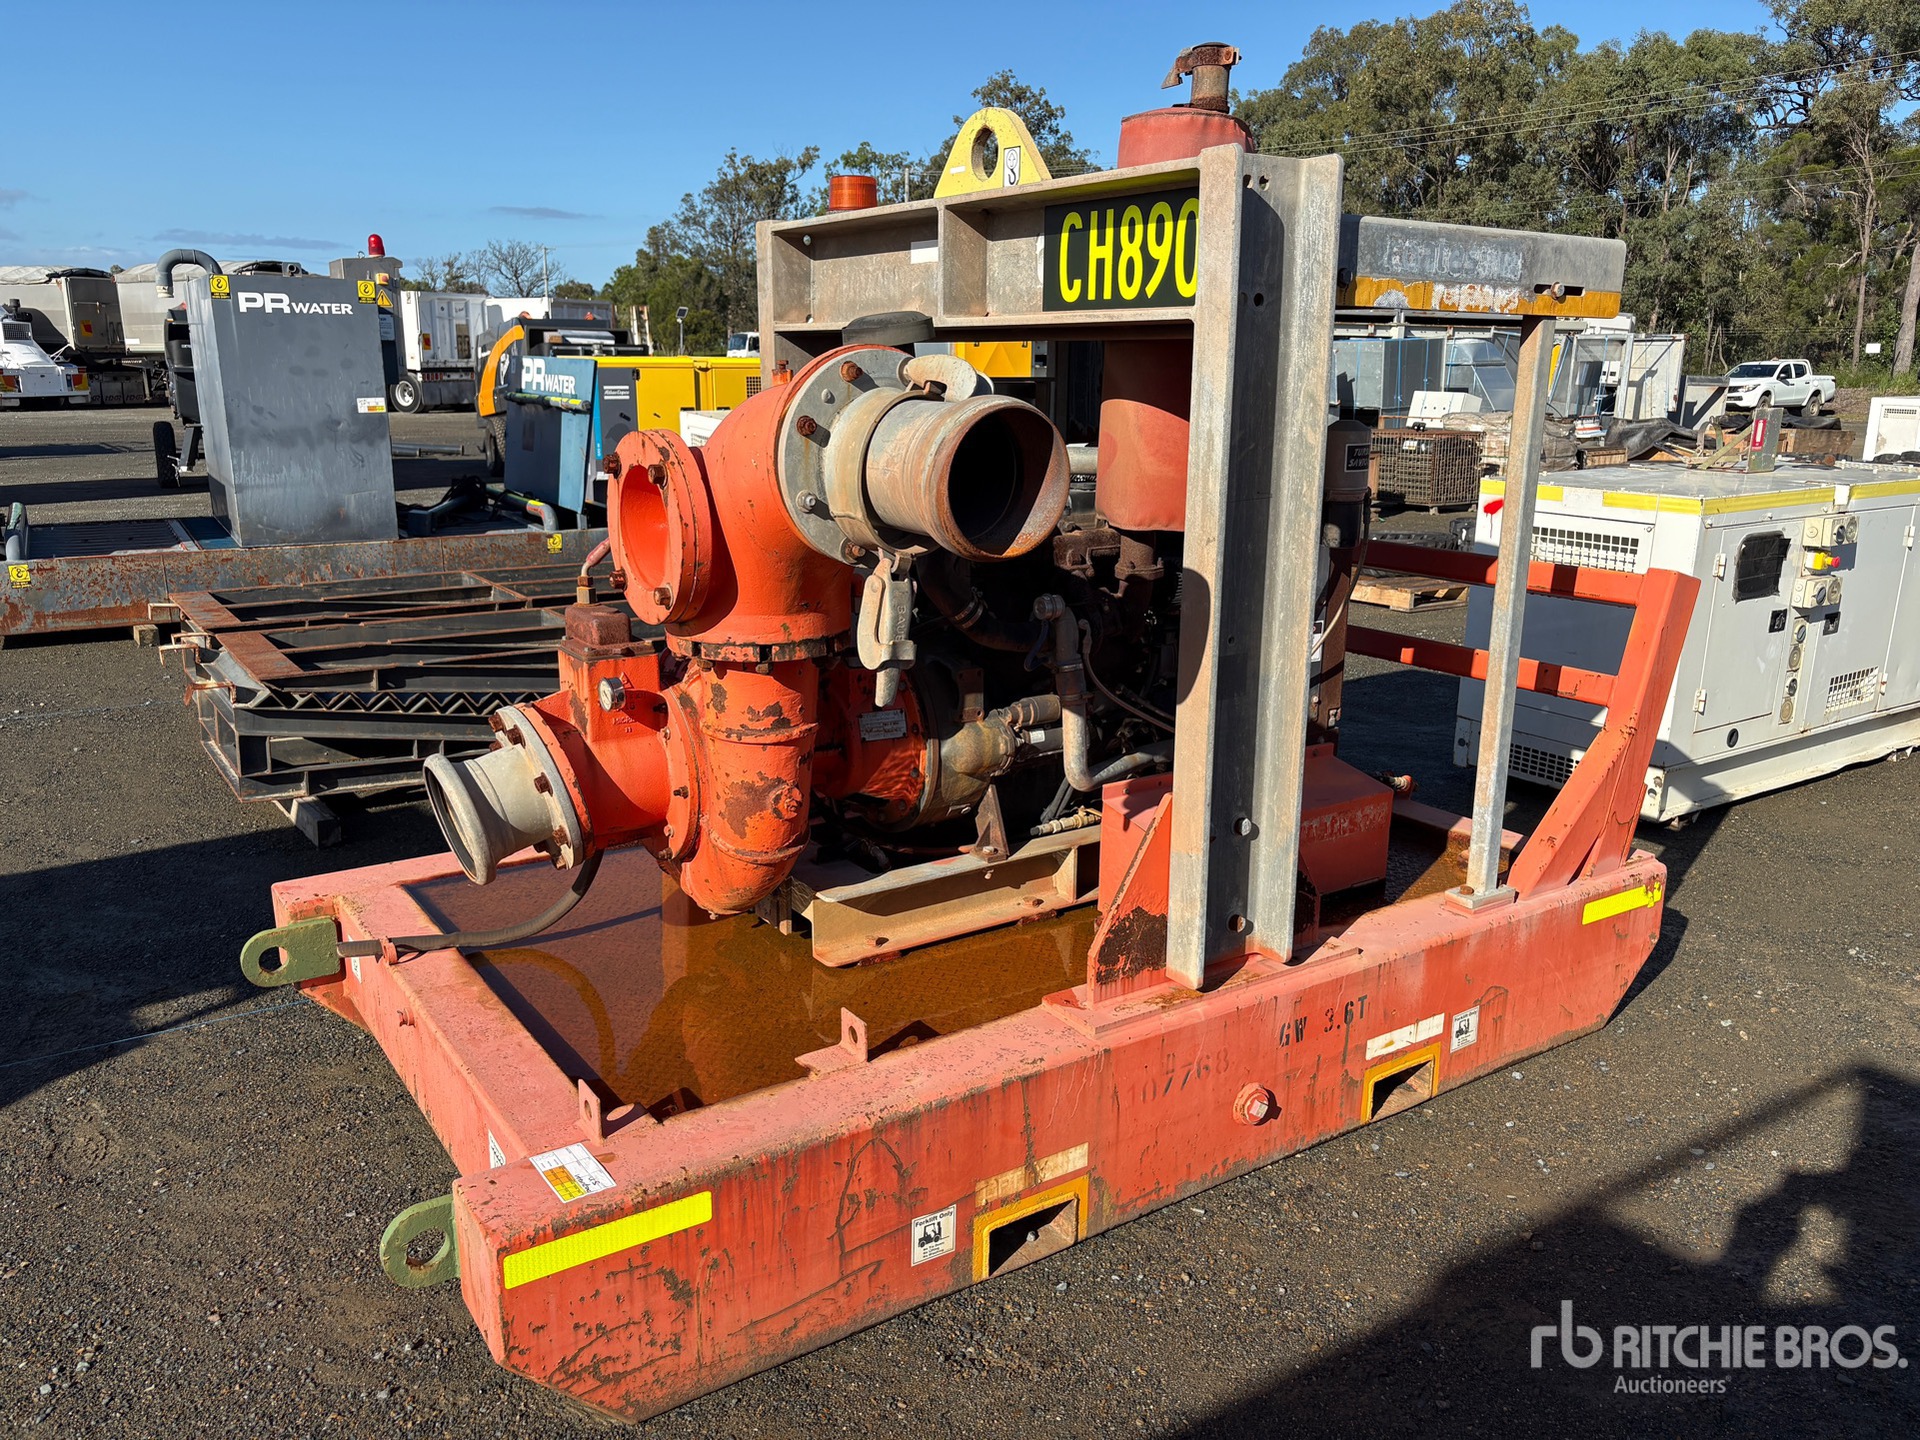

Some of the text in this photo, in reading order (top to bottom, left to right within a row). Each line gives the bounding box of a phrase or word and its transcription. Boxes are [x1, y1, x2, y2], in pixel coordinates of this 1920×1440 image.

[1059, 197, 1199, 303] CH890
[237, 291, 354, 315] PR WATER
[521, 357, 576, 395] PR WATER
[1279, 994, 1368, 1048] GW 3.6T
[915, 1216, 938, 1227] Forklift
